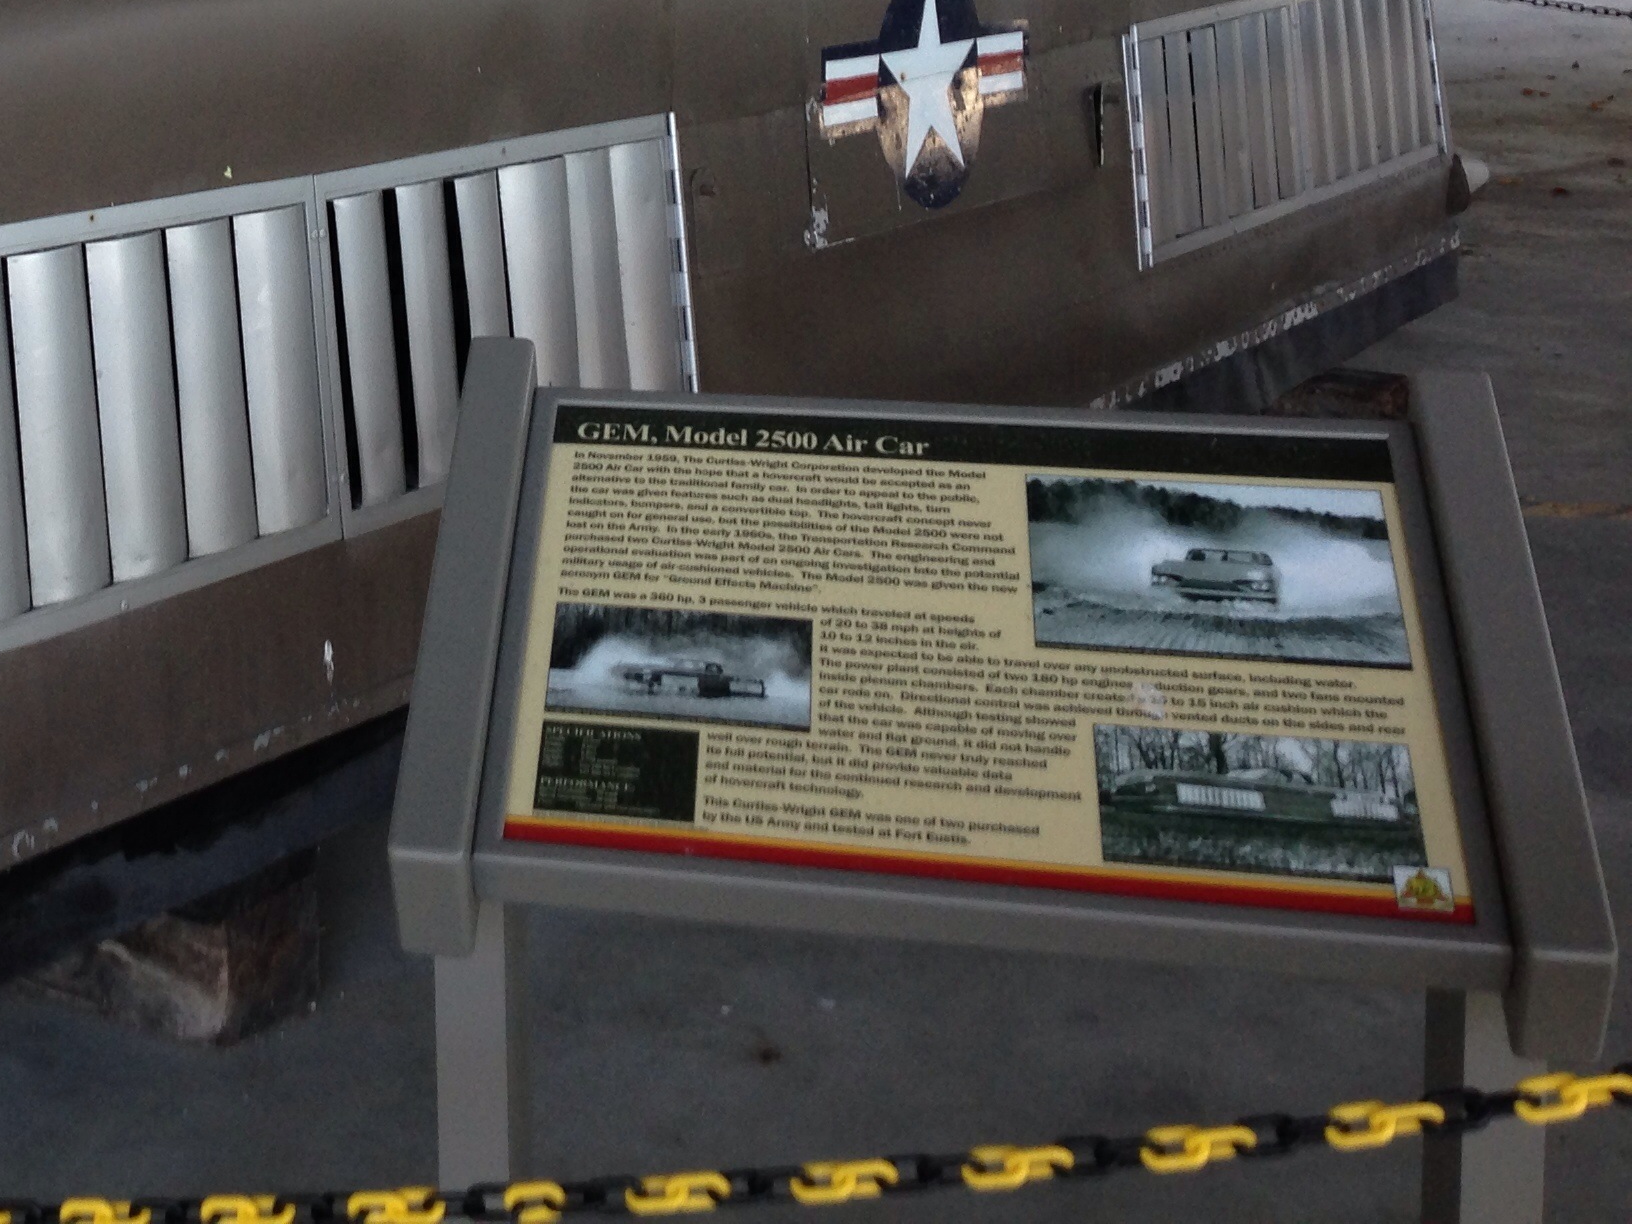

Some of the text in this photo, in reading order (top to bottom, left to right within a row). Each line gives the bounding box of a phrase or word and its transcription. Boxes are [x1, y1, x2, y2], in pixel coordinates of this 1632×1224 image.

[578, 423, 928, 454] GEM, Model 2500 Air Car
[574, 451, 585, 459] In
[587, 451, 643, 461] November
[682, 455, 703, 464] The
[862, 465, 922, 476] developed
[925, 469, 945, 477] the
[948, 469, 986, 479] Model
[605, 463, 621, 471] Air
[623, 463, 643, 472] Car
[646, 465, 670, 473] with
[673, 466, 692, 475] the
[694, 467, 723, 477] hope
[725, 469, 749, 478] that
[824, 476, 859, 484] would
[861, 477, 877, 485] be
[880, 479, 935, 489] accepted
[570, 484, 588, 493] the
[636, 488, 668, 497] given
[670, 489, 718, 499] features
[720, 493, 748, 501] such
[751, 495, 765, 503] as
[767, 495, 793, 504] dual
[863, 501, 883, 510] tail
[925, 504, 950, 513] turn
[634, 476, 645, 484] to
[648, 476, 667, 485] the
[730, 481, 765, 492] family
[796, 485, 807, 493] In
[810, 487, 841, 495] order
[843, 488, 856, 496] to
[858, 490, 899, 499] appeal
[901, 491, 914, 499] to
[916, 492, 937, 501] the
[567, 509, 606, 519] caught
[609, 511, 624, 519] on
[626, 511, 642, 519] for
[644, 513, 688, 522] general
[718, 516, 737, 525] but
[740, 517, 759, 526] the
[835, 523, 847, 532] of
[850, 524, 870, 533] the
[872, 525, 910, 535] Model
[949, 532, 980, 540] were
[983, 533, 1004, 542] not
[686, 502, 708, 511] and
[711, 504, 719, 512] a
[817, 509, 839, 519] The
[905, 517, 955, 527] concept
[957, 519, 991, 528] never
[564, 533, 624, 543] purchased
[627, 535, 648, 544] two
[737, 541, 775, 552] Model
[813, 546, 830, 555] Air
[870, 550, 892, 560] The
[971, 558, 995, 566] and
[566, 520, 587, 529] lost
[607, 521, 626, 530] the
[666, 525, 677, 533] In
[680, 525, 699, 535] the
[702, 528, 731, 538] early
[778, 532, 797, 541] the
[890, 539, 948, 550] Research
[951, 543, 1015, 555] Command
